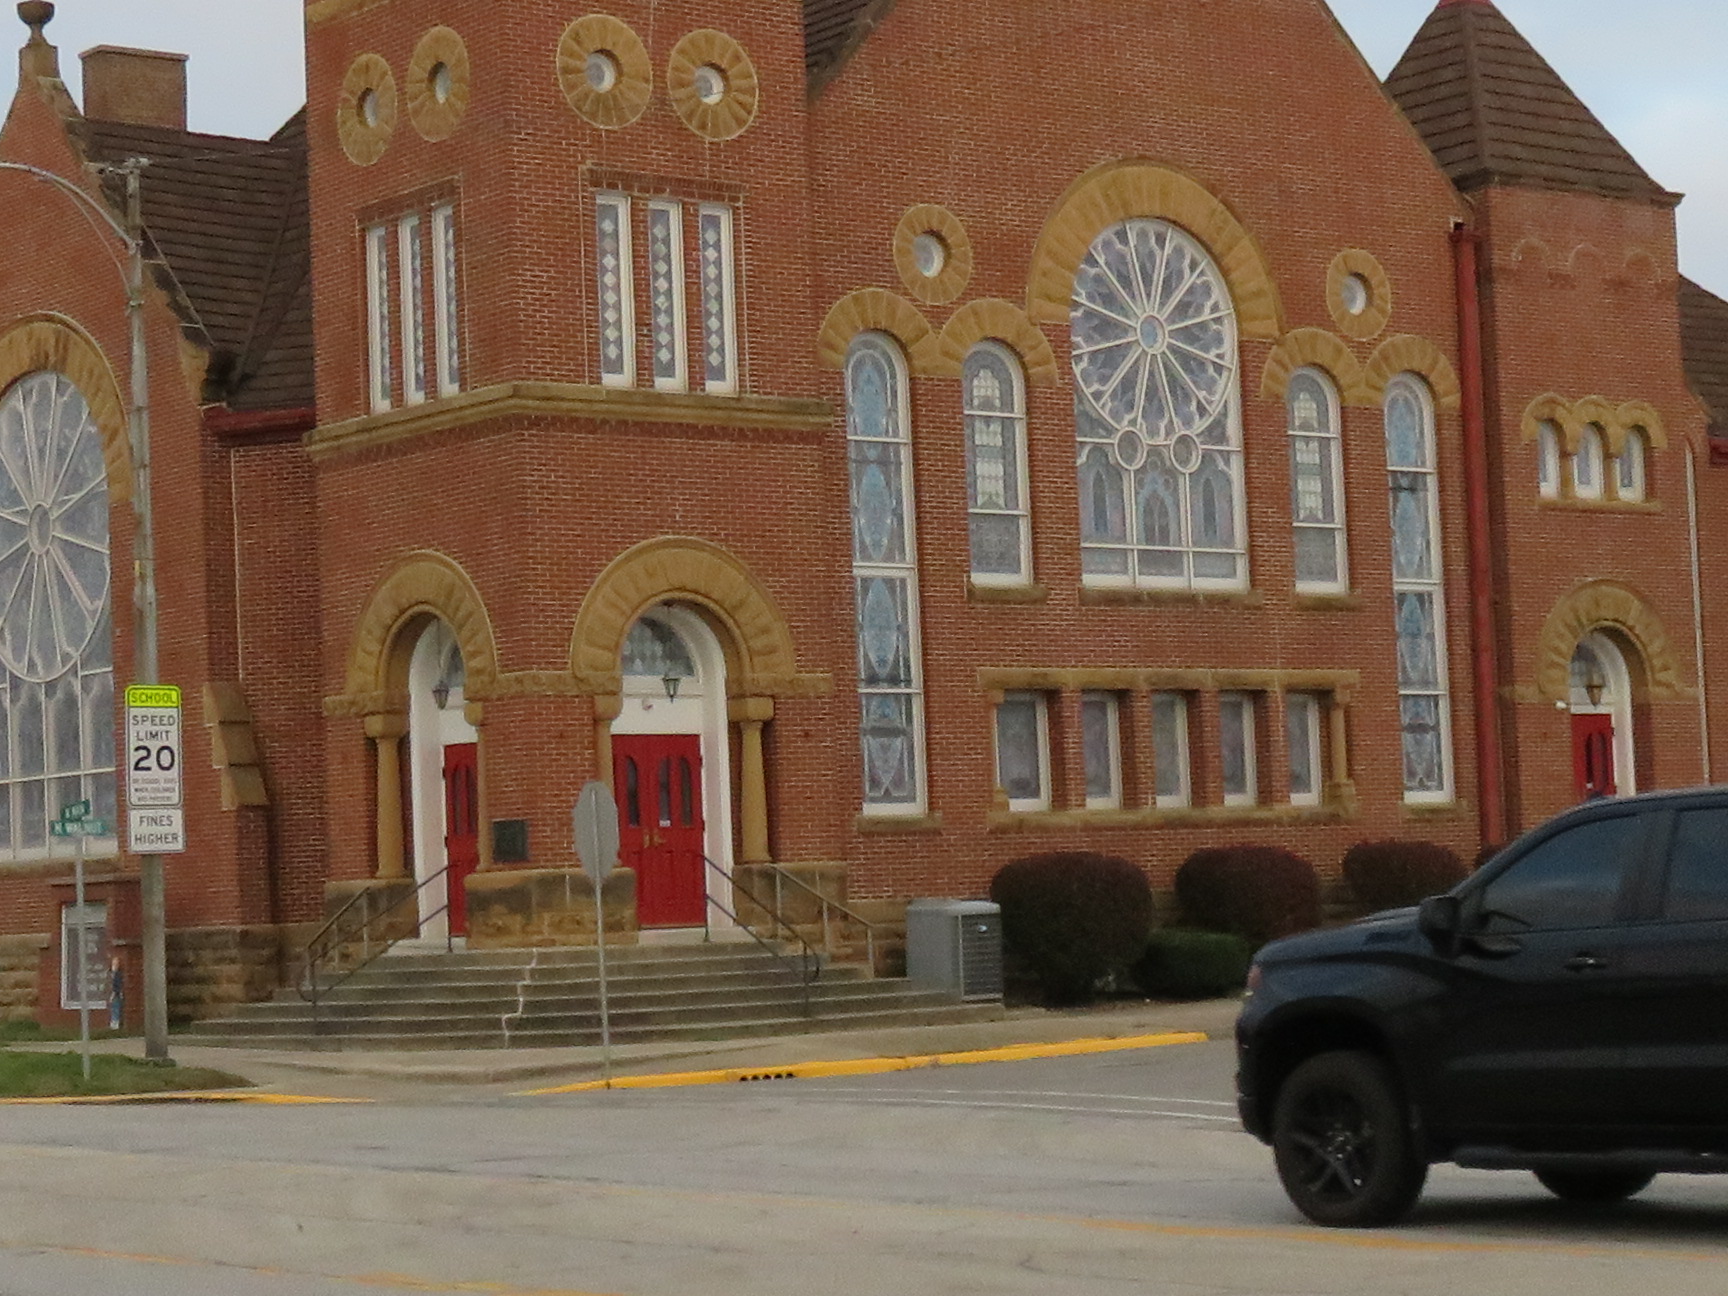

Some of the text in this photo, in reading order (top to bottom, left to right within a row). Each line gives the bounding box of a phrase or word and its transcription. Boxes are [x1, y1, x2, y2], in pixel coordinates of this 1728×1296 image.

[131, 691, 177, 704] SCHOOL
[132, 714, 176, 726] SPEED
[136, 730, 170, 742] LIMIT
[133, 745, 175, 771] 20
[138, 815, 173, 827] FINES
[134, 833, 179, 845] HIGHER
